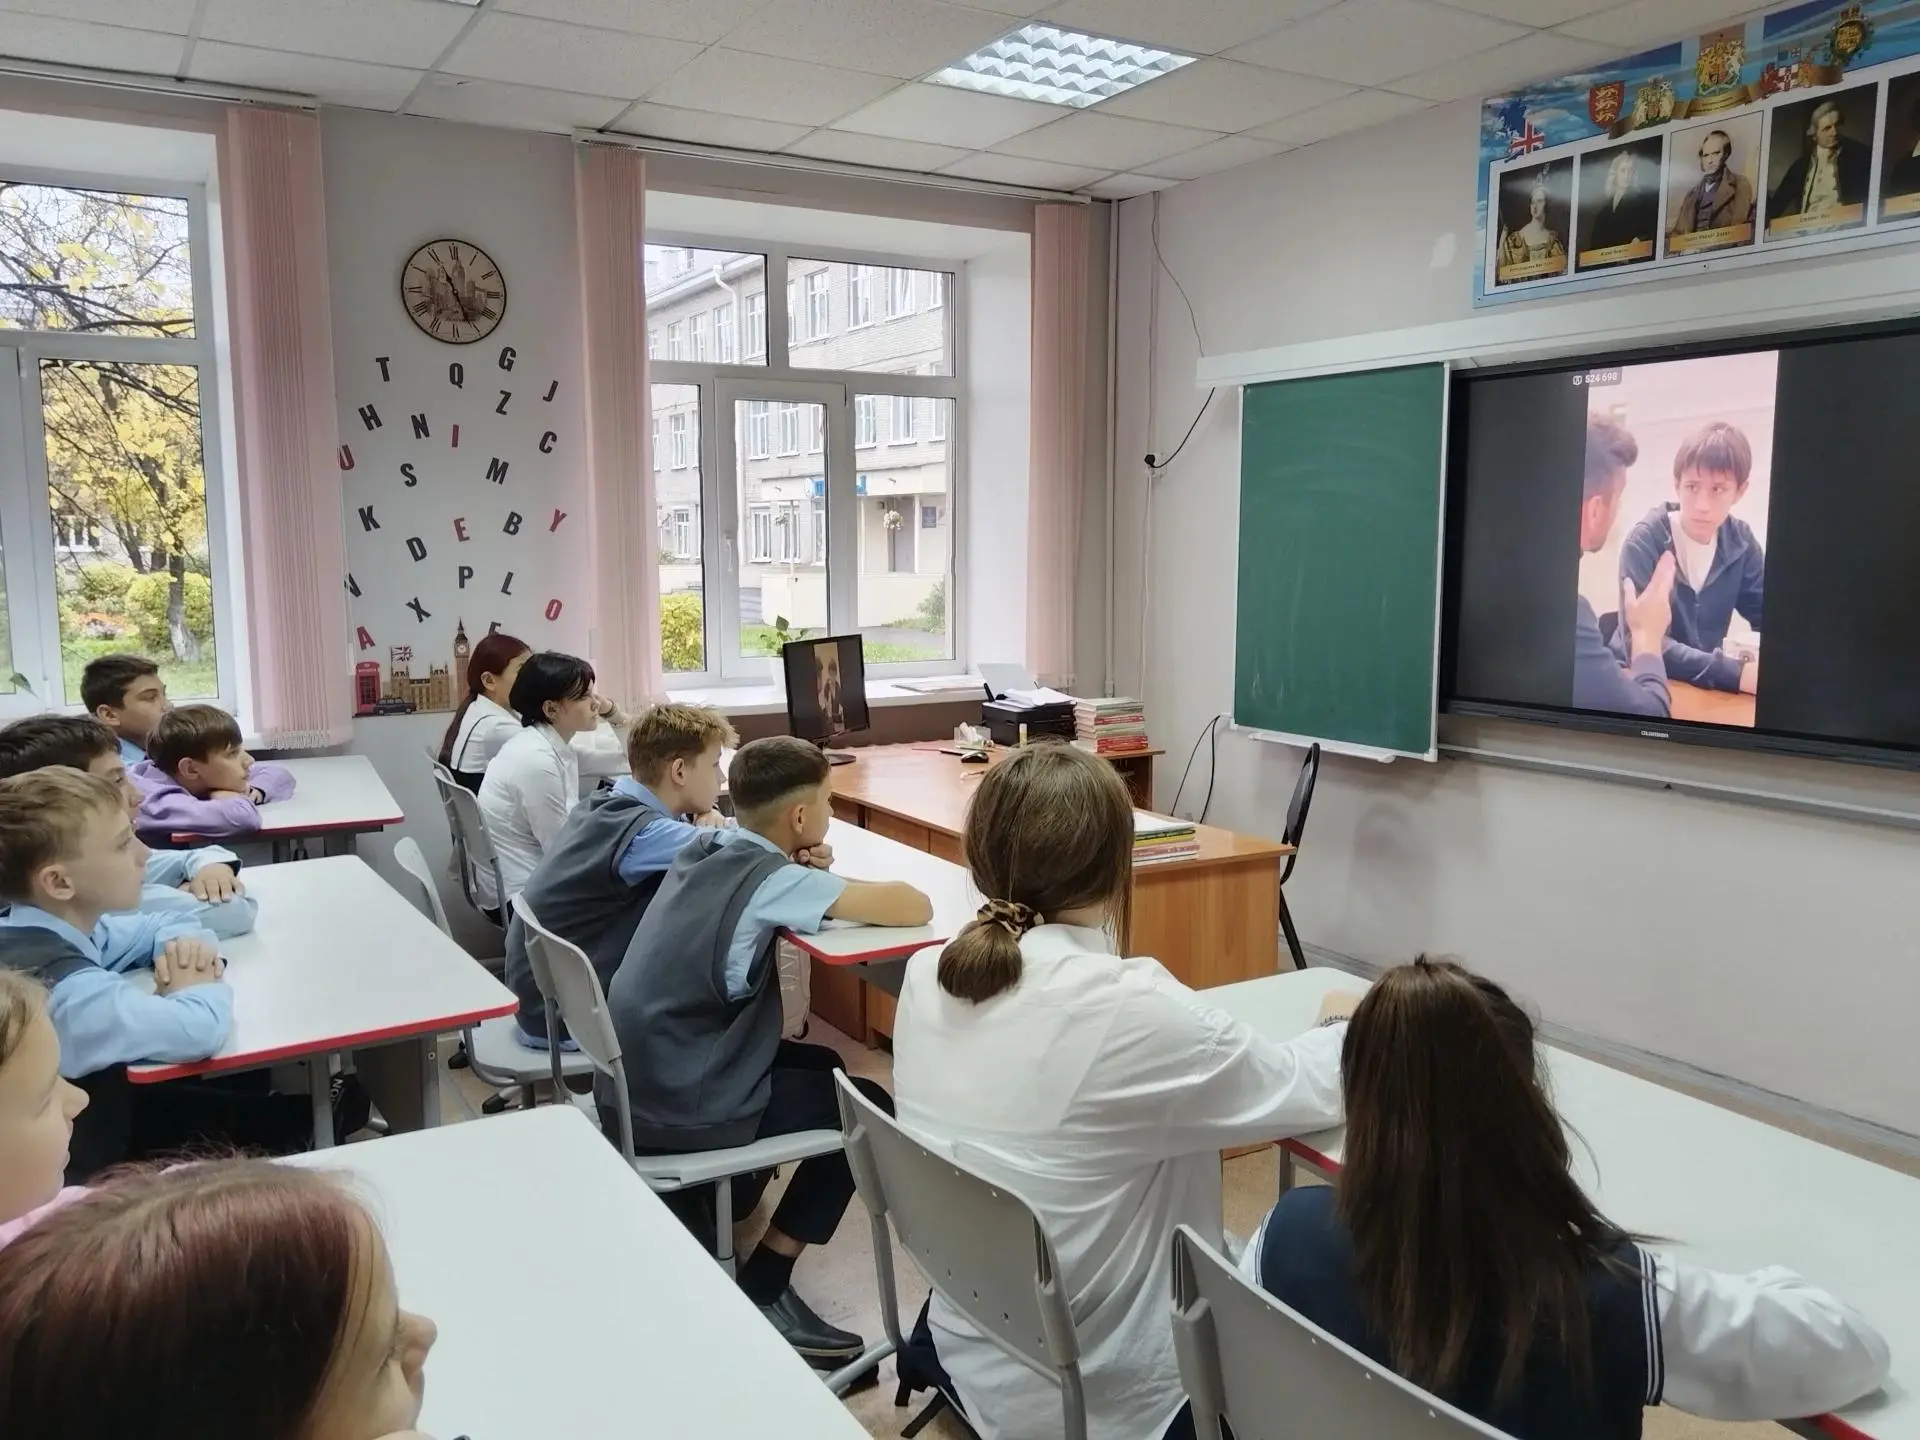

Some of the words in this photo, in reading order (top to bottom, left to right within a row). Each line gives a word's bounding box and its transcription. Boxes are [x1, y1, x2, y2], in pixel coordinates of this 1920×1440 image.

[375, 356, 390, 382] T
[499, 346, 517, 372] G
[449, 362, 464, 389] Q
[495, 389, 512, 416] Z
[542, 380, 559, 402] J
[358, 403, 383, 431] H
[410, 413, 430, 440] N
[539, 430, 558, 454] C
[338, 444, 355, 470] U
[400, 462, 417, 487] S
[485, 456, 510, 485] M
[358, 504, 381, 532] K
[453, 517, 470, 542] E
[502, 510, 523, 536] B
[549, 508, 567, 533] Y
[405, 536, 428, 563] D
[458, 565, 474, 589] P
[500, 571, 514, 596] L
[405, 596, 432, 623] X
[544, 598, 563, 622] O
[356, 625, 376, 651] A
